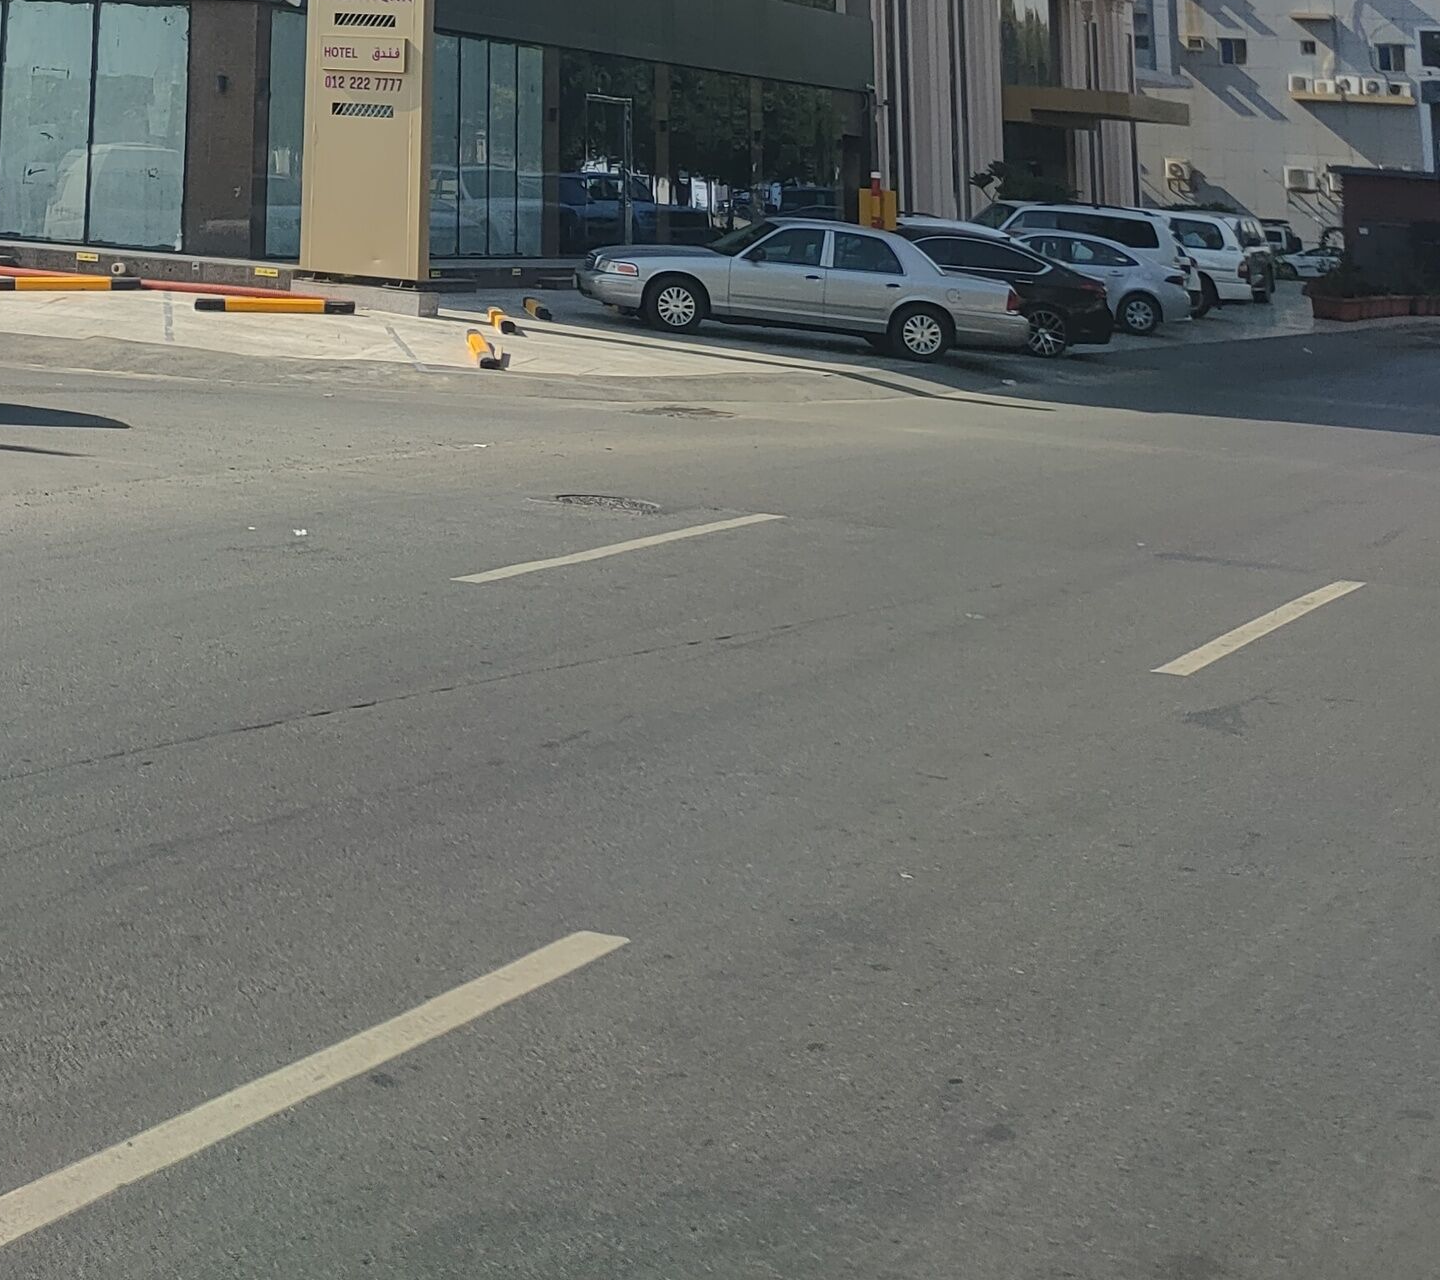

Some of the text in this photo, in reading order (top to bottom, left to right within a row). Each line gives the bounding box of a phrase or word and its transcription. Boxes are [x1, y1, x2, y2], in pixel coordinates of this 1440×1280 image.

[324, 46, 359, 60] HOTEL
[371, 46, 401, 62] فندق
[324, 75, 403, 92] 012 222 7777
